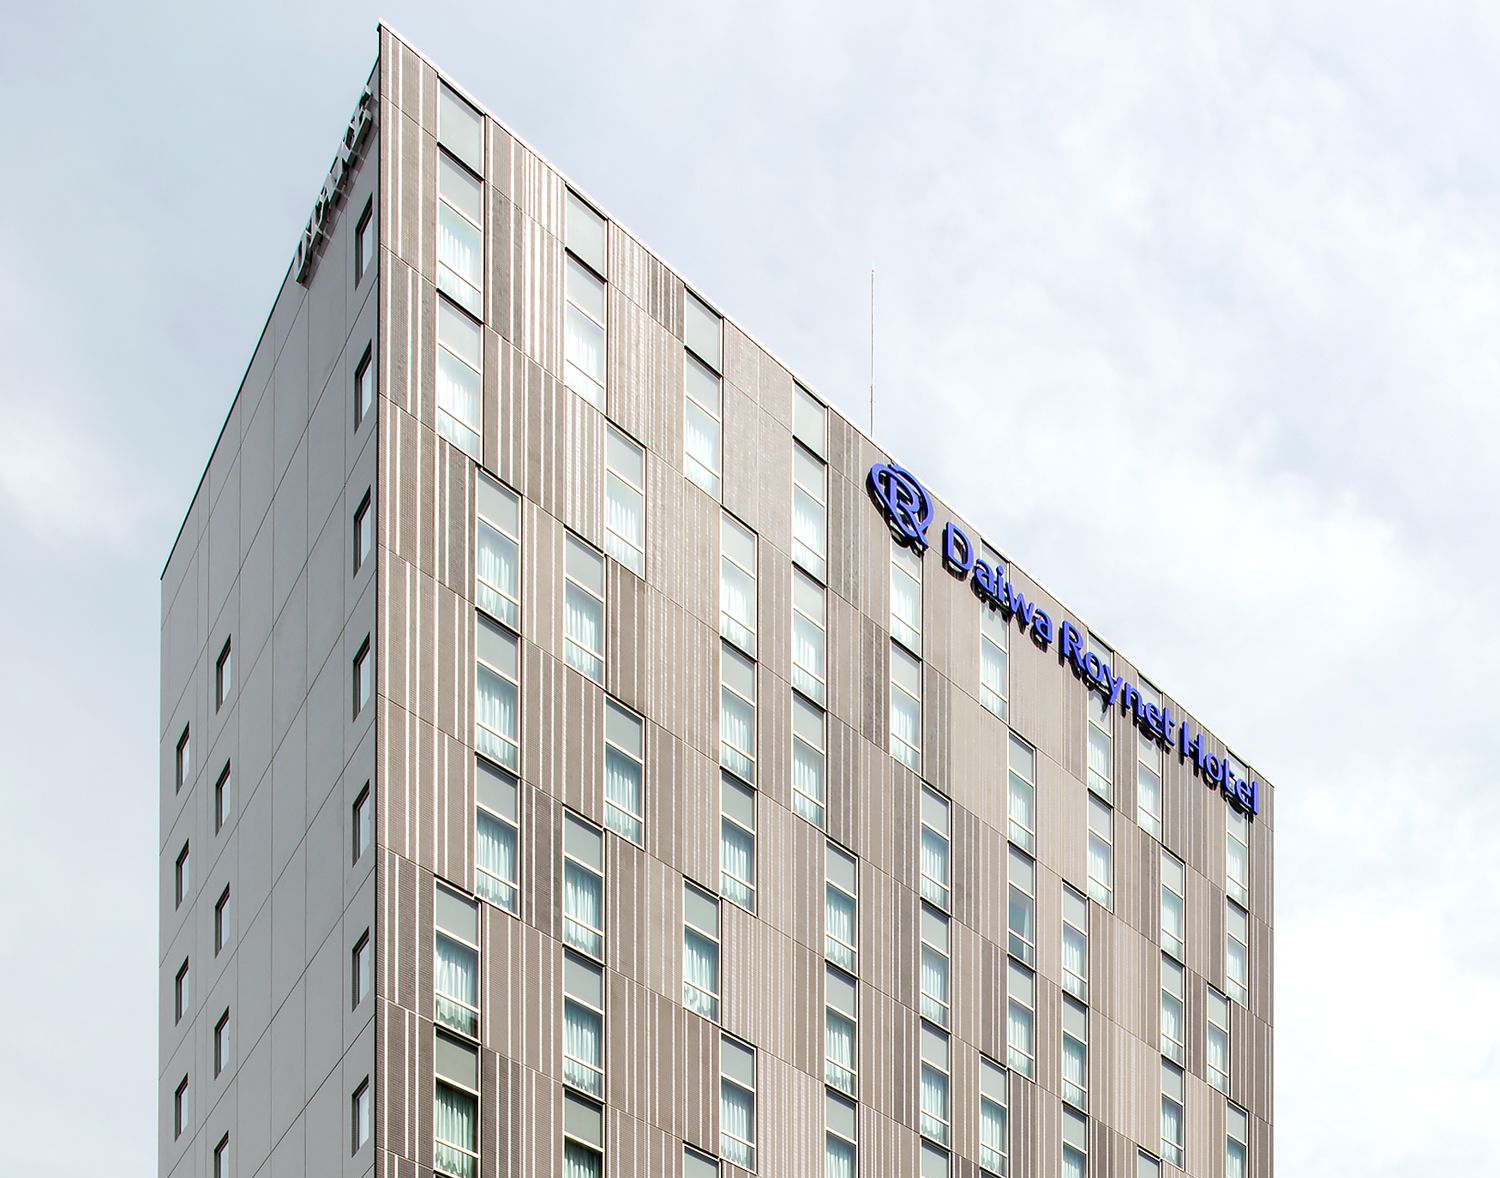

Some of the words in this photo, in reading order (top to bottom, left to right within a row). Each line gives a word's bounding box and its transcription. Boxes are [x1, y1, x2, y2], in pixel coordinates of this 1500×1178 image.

[943, 521, 1053, 648] Daiwa
[1060, 620, 1176, 750] Roynet
[1179, 721, 1260, 817] Hotel
